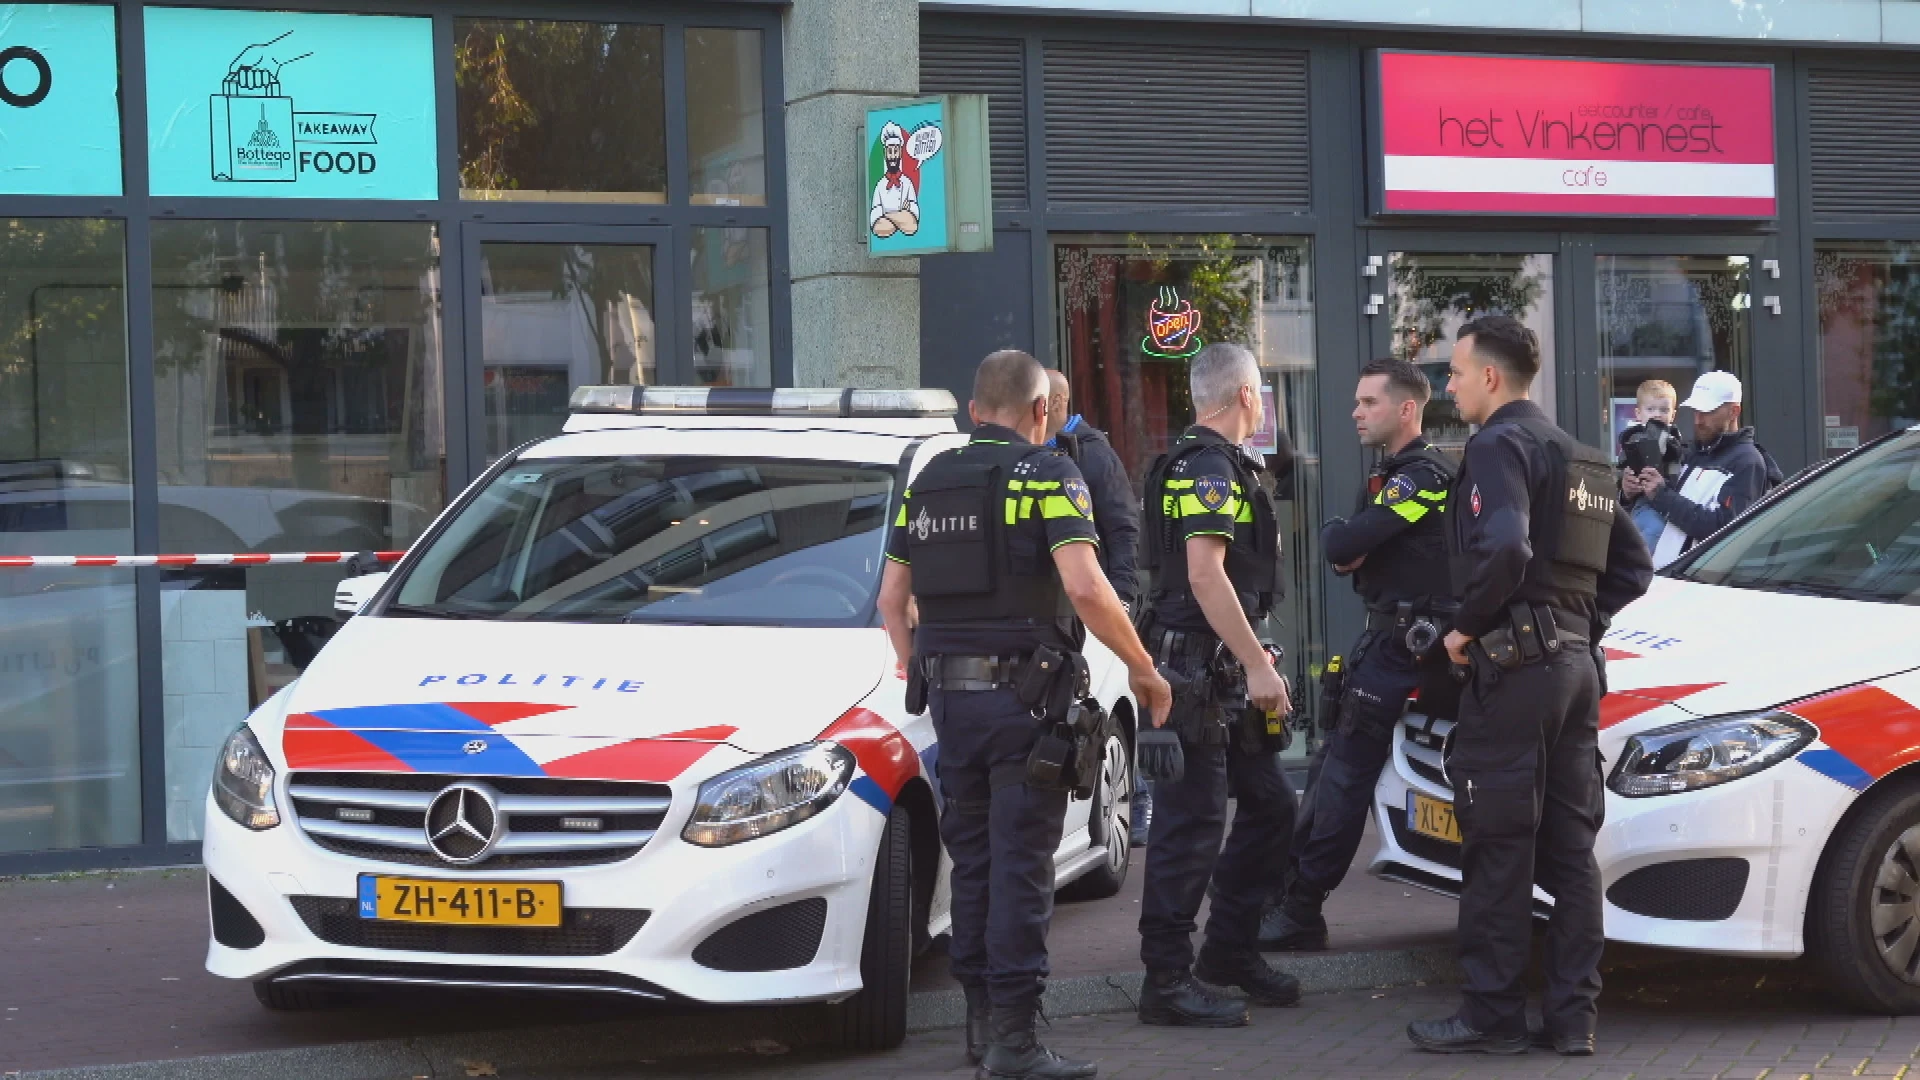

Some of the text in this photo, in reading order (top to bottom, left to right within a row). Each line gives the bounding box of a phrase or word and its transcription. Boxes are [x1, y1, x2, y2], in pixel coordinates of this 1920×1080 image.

[1677, 105, 1710, 121] cafe
[297, 121, 368, 136] TAKEAWAY
[1439, 106, 1724, 154] het Vinkennest
[299, 150, 377, 175] FOOD
[1562, 166, 1608, 187] cafe
[1569, 478, 1615, 513] POLITIE
[908, 506, 978, 540] POLITIE
[418, 673, 645, 693] POLITIE
[361, 901, 375, 912] NL
[393, 884, 537, 919] ZH-411-B
